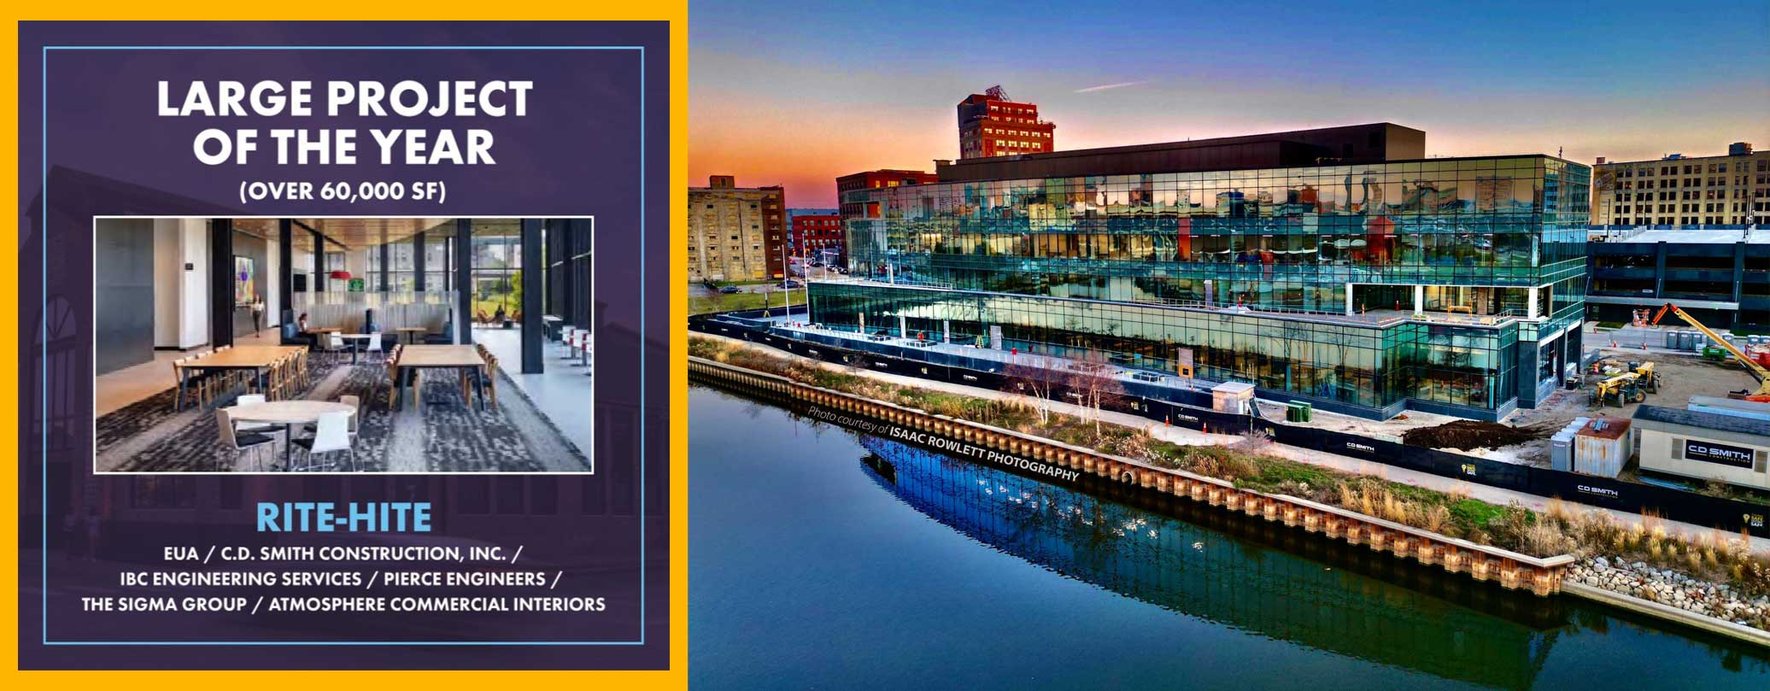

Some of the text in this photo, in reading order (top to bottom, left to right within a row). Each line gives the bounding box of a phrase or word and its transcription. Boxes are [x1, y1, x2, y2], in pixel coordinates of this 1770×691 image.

[159, 80, 534, 117] LARGE PROJECT
[193, 128, 497, 166] OF THE YEAR
[239, 181, 446, 204] (OVER 60,000 SF)
[1688, 445, 1751, 460] CD SMITH
[1591, 487, 1618, 496] SMITH
[257, 502, 432, 532] RITE-HITE
[164, 546, 200, 561] EUA
[221, 546, 255, 561] C.D.
[260, 546, 314, 561] SMITH
[319, 546, 465, 563] CONSTRUCTION,
[469, 546, 507, 561] INC.
[120, 571, 148, 586] IBC
[153, 571, 277, 587] ENGINEERING
[281, 571, 362, 586] SERVICES
[384, 571, 442, 586] PIERCE
[446, 571, 546, 587] ENGINEERS
[82, 597, 114, 612] THE
[118, 597, 178, 612] SIGMA
[182, 597, 247, 612] GROUP
[268, 597, 386, 612] ATMOSPHERE
[390, 597, 509, 612] COMMERCIAL
[513, 597, 606, 612] INTERIORS
